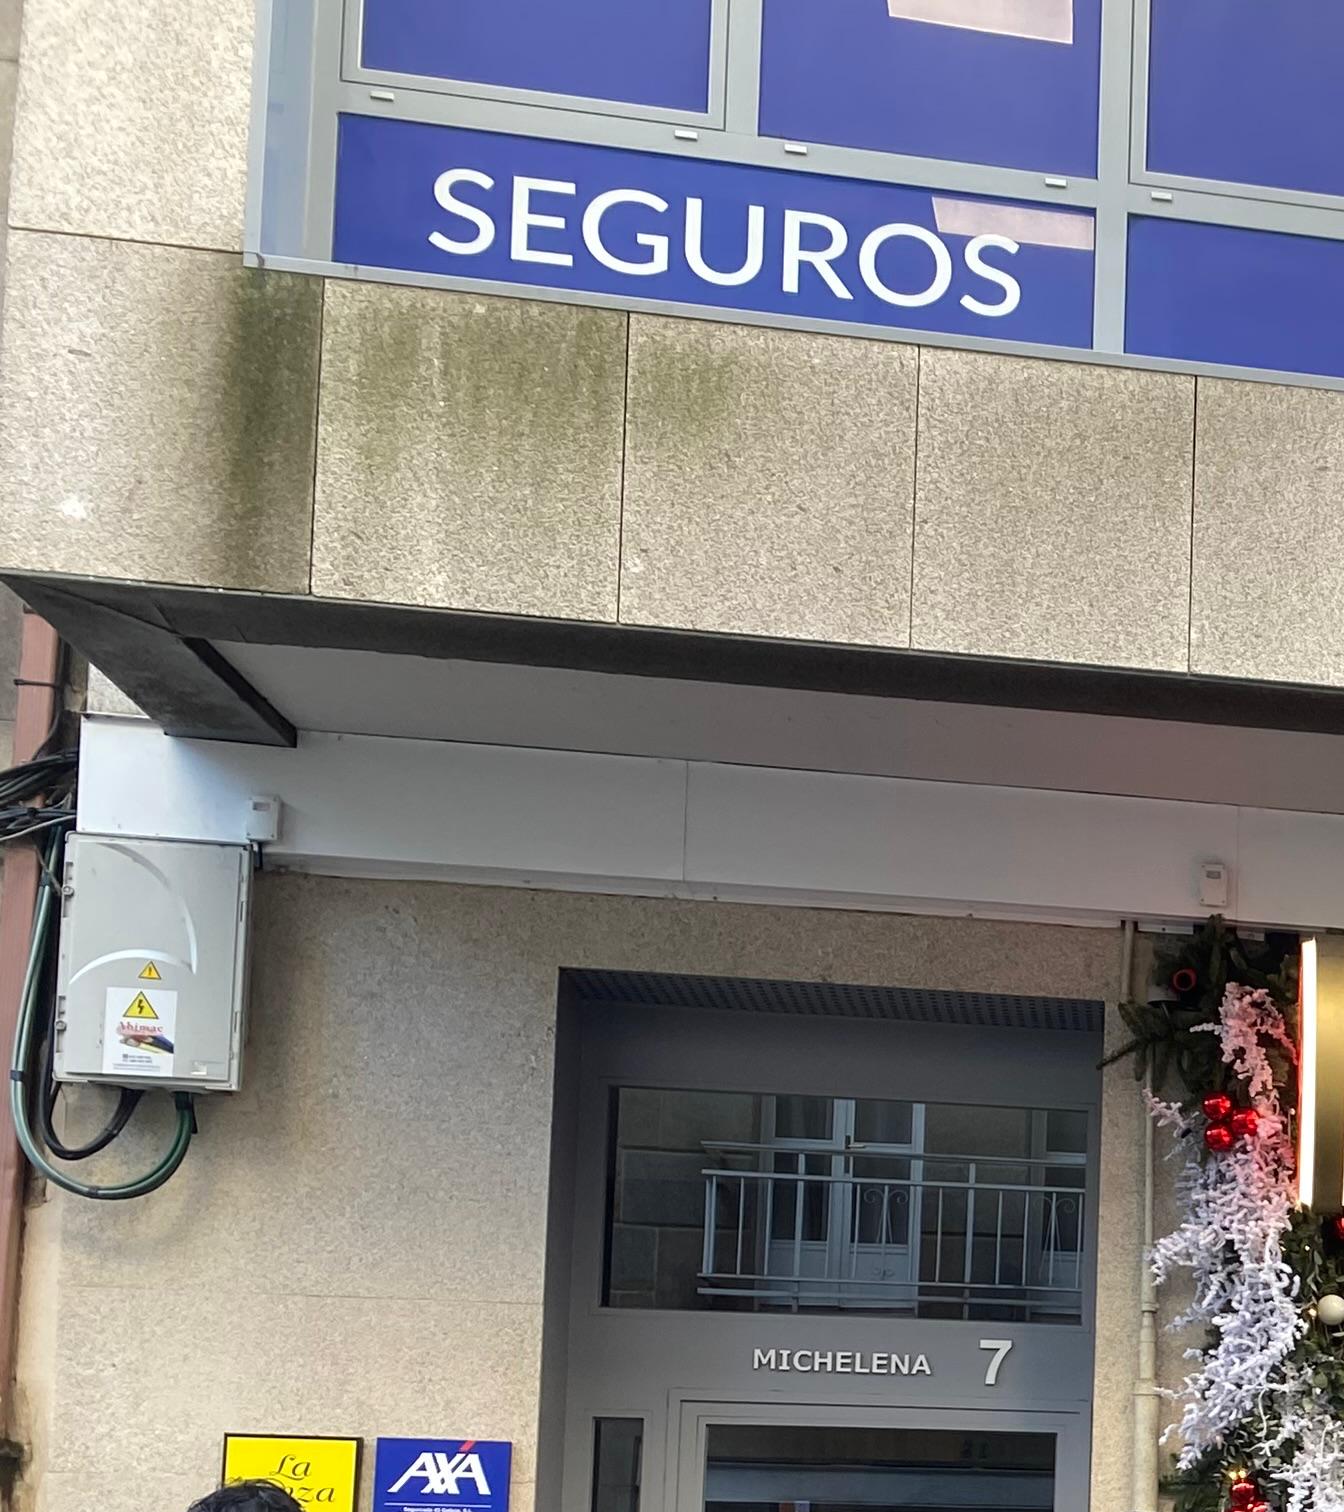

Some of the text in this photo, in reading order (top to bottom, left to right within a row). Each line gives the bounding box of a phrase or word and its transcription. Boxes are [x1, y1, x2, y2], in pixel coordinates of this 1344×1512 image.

[428, 168, 1021, 318] SEGUROS
[753, 1339, 1013, 1386] MICHELENA 7
[269, 1454, 312, 1481] La
[387, 1452, 492, 1496] AXA
